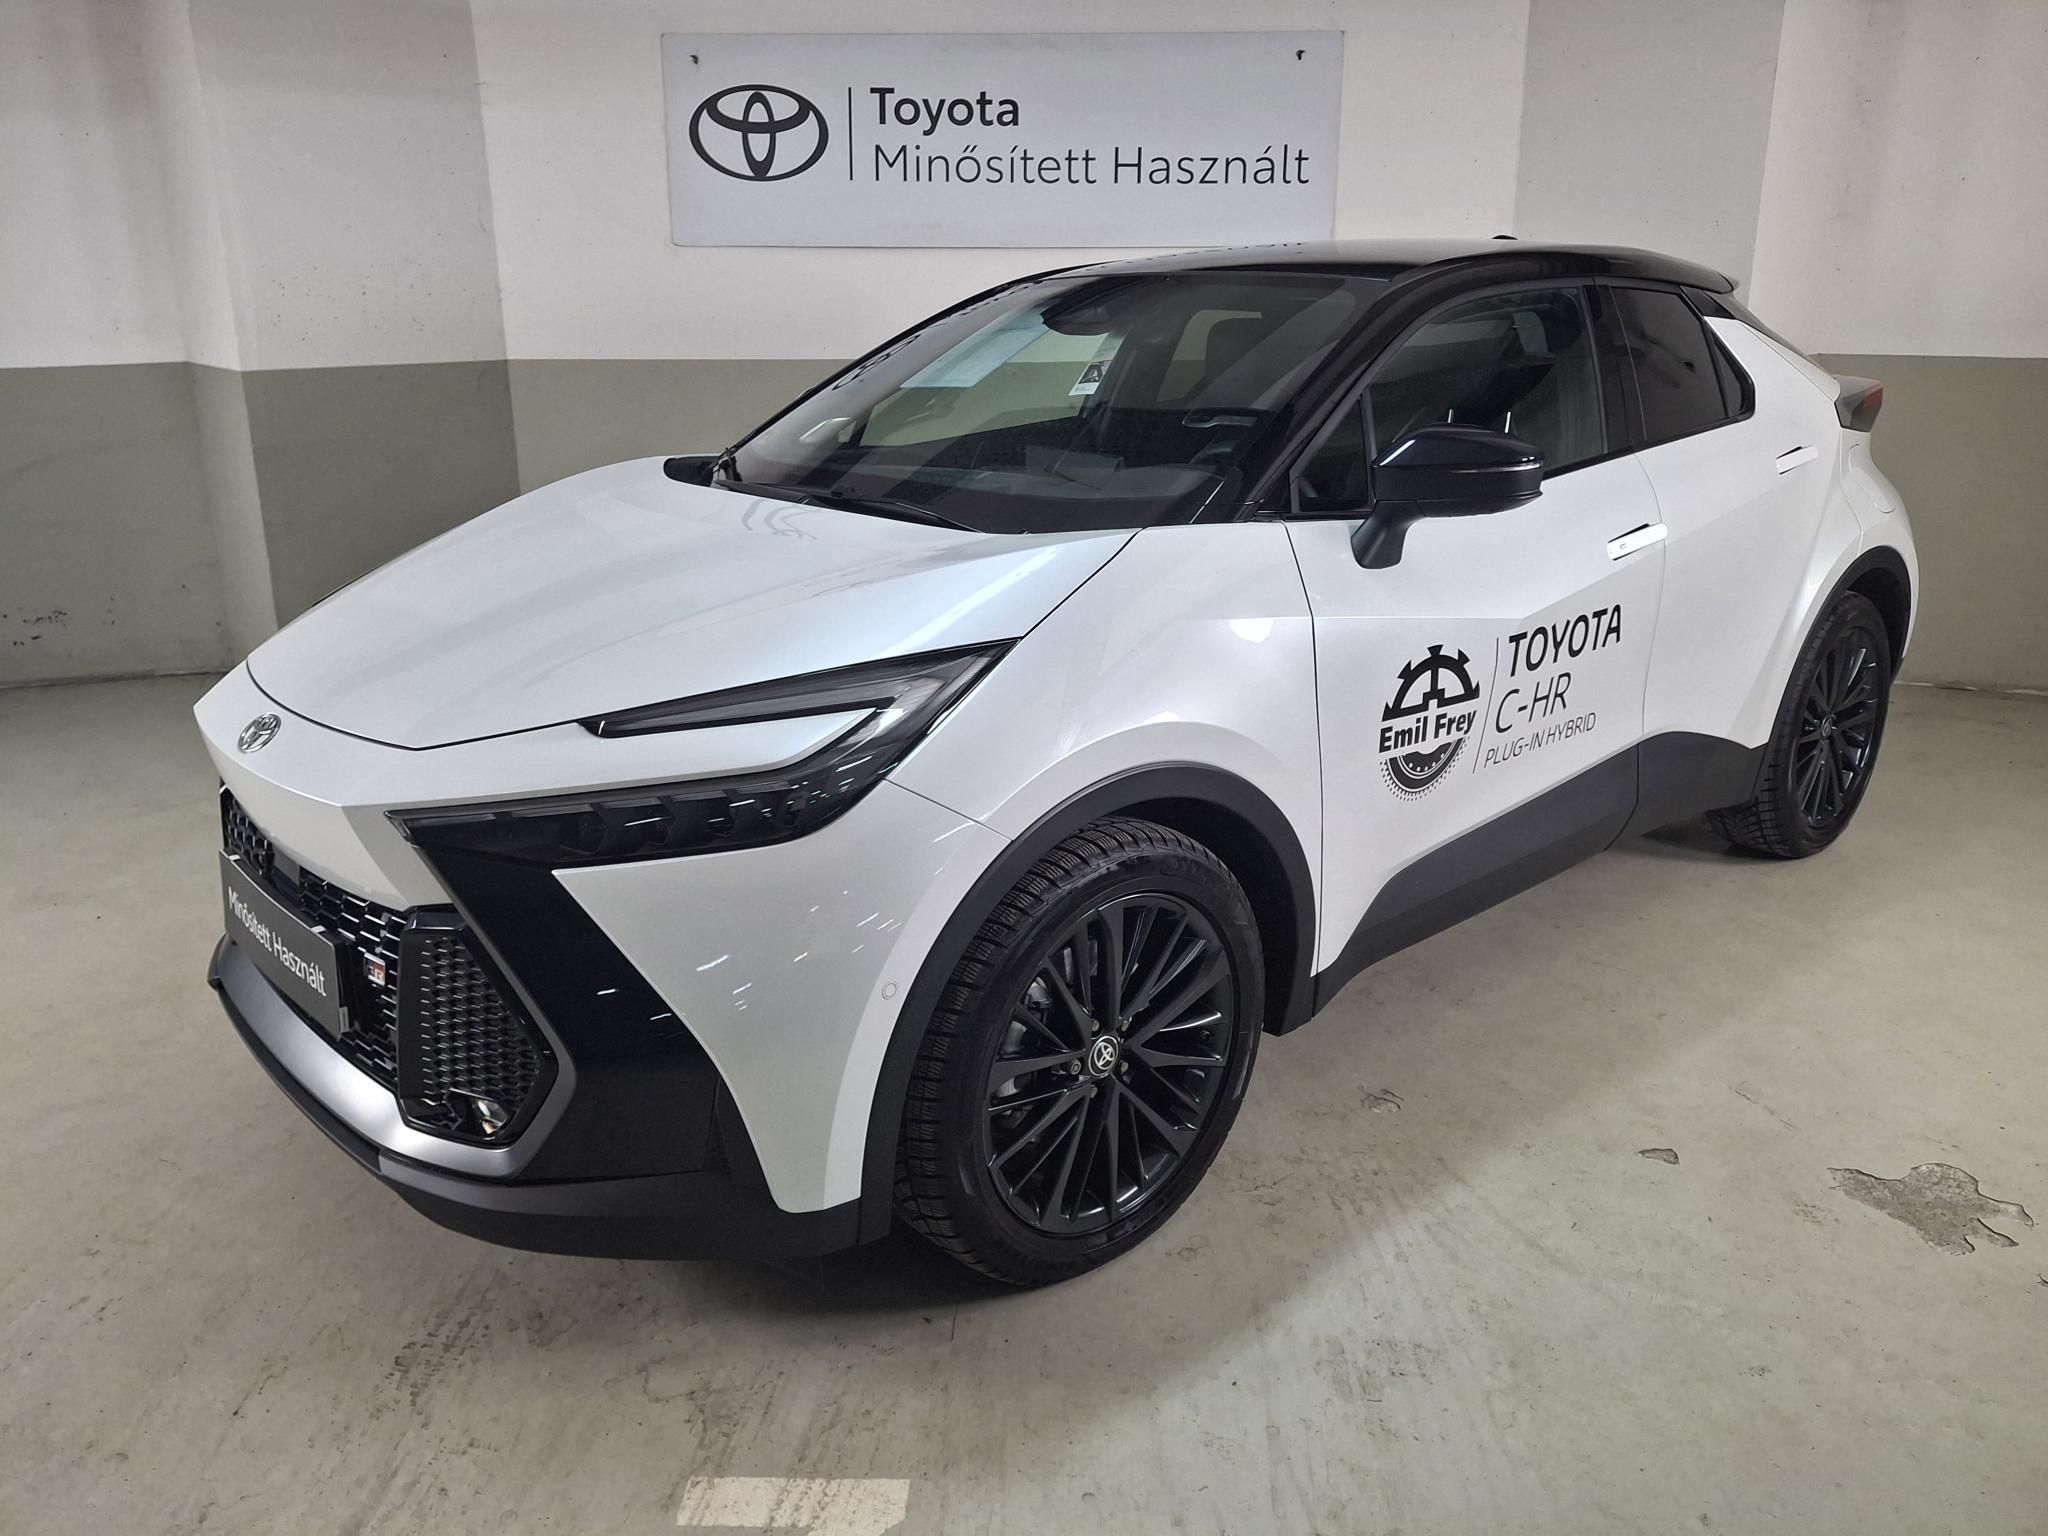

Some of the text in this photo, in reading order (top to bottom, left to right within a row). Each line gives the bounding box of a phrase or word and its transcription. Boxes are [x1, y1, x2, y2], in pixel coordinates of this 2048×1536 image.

[870, 87, 1020, 136] Toyota
[874, 144, 1310, 185] Minősített Használt
[1508, 603, 1622, 677] TOYOTA
[1378, 709, 1478, 754] Emil Frey
[1495, 672, 1572, 734] C-HR
[1483, 712, 1597, 769] PLUG-IN HYBRID
[271, 931, 327, 997] Használt
